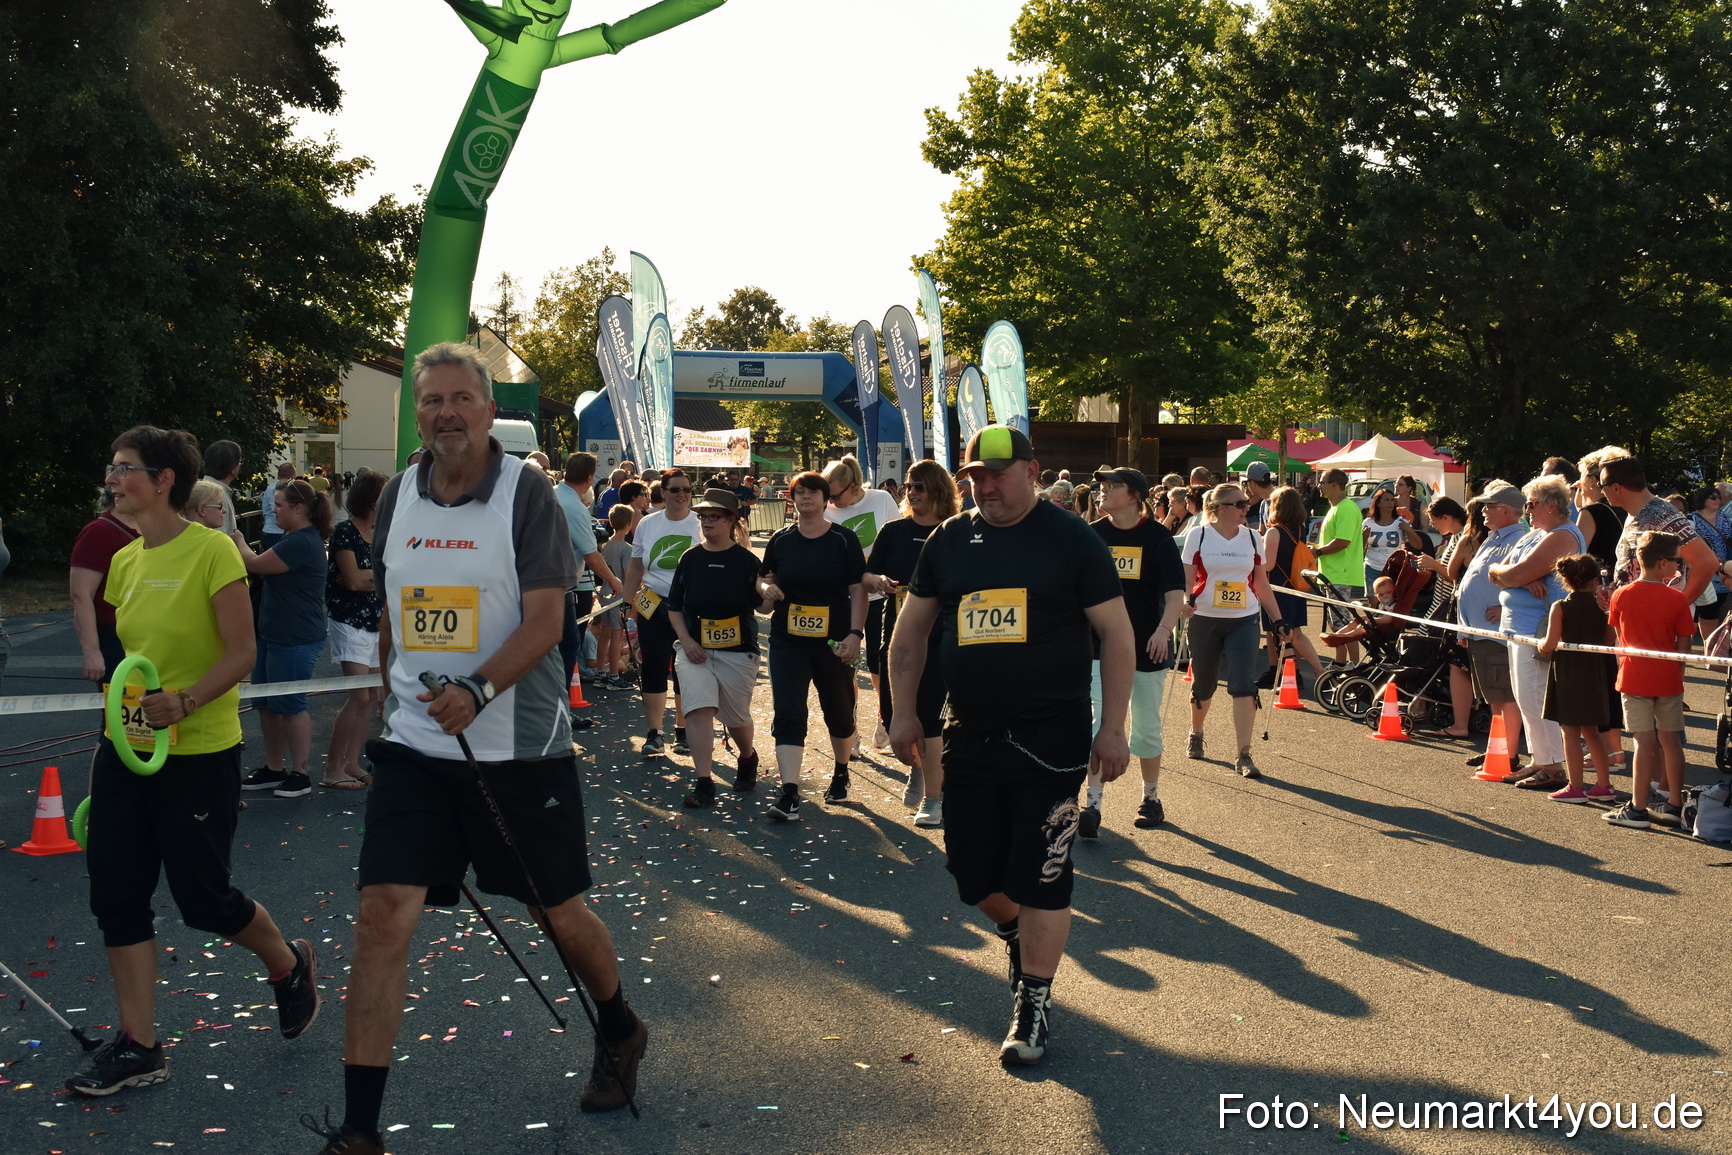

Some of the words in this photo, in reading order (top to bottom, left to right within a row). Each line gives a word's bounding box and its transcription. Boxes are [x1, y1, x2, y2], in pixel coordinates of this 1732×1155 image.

[452, 80, 532, 209] AOK
[729, 377, 786, 388] firmenlauf
[424, 538, 478, 550] KLEBL
[1370, 530, 1400, 548] 79
[1221, 590, 1241, 602] 822
[414, 609, 458, 633] 870
[792, 615, 824, 629] 1652
[966, 607, 1017, 629] 1704
[706, 627, 736, 641] 1653
[121, 705, 153, 729] 94
